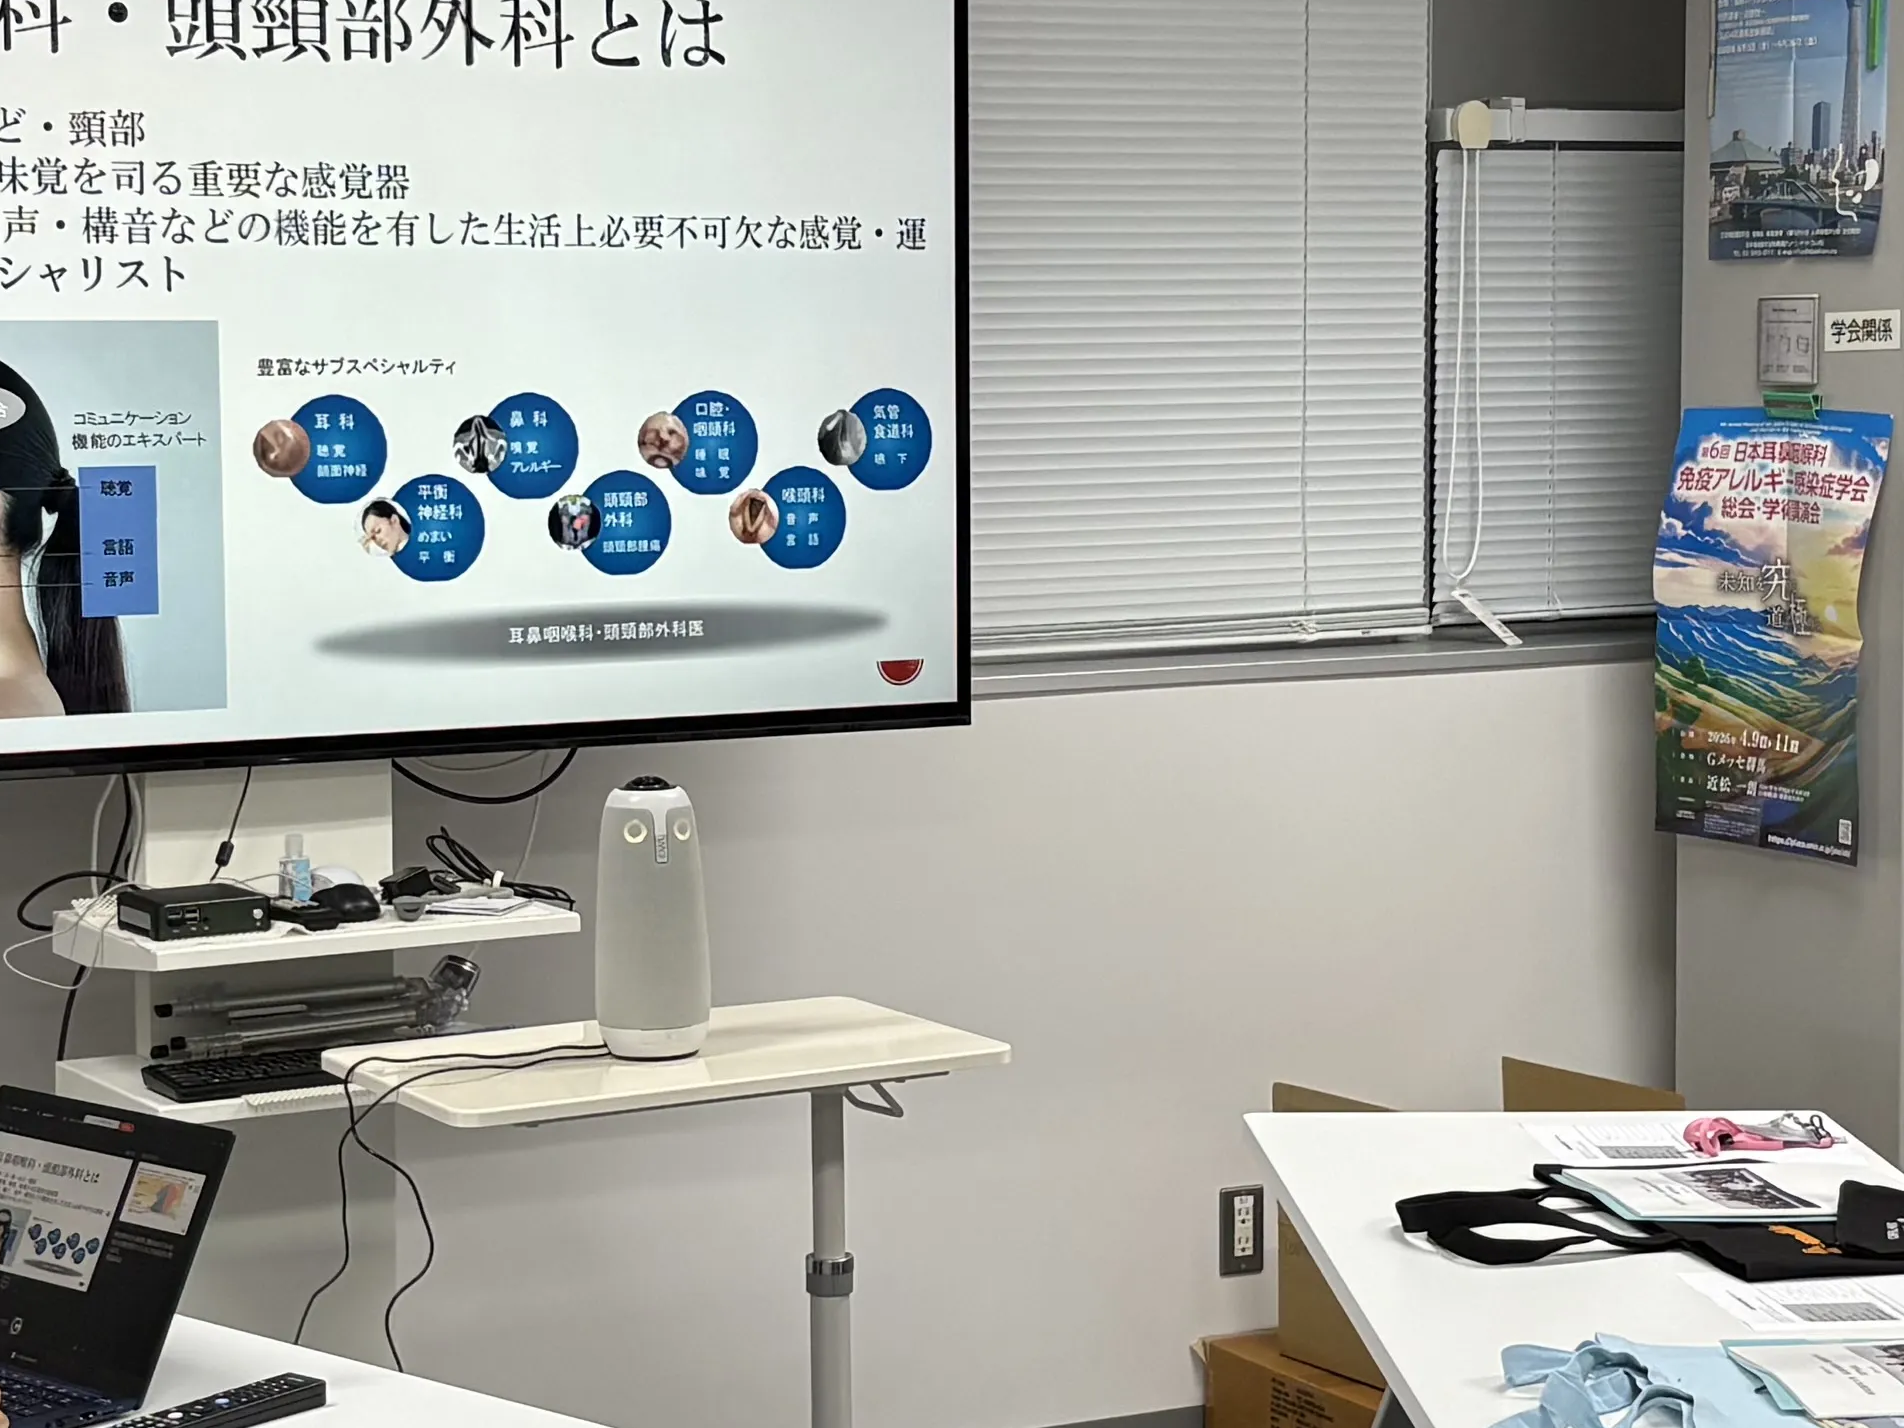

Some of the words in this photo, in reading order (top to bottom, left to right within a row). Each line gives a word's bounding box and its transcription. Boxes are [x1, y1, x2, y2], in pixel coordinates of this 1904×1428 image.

[1829, 317, 1893, 346] 学会関係
[256, 356, 457, 377] 豊富なサブスペシャルティ
[72, 410, 193, 428] コミュニケーション
[314, 413, 356, 431] 耳科
[509, 410, 549, 429] 鼻科
[71, 430, 209, 451] 機能のエキスパート
[873, 422, 915, 441] 食道科
[509, 460, 563, 474] アレルギー
[99, 479, 134, 498] 聴覚
[417, 503, 464, 522] 神経科
[603, 511, 634, 529] 外科
[416, 529, 453, 544] めまい
[102, 538, 136, 557] 言語
[102, 570, 136, 589] 音声
